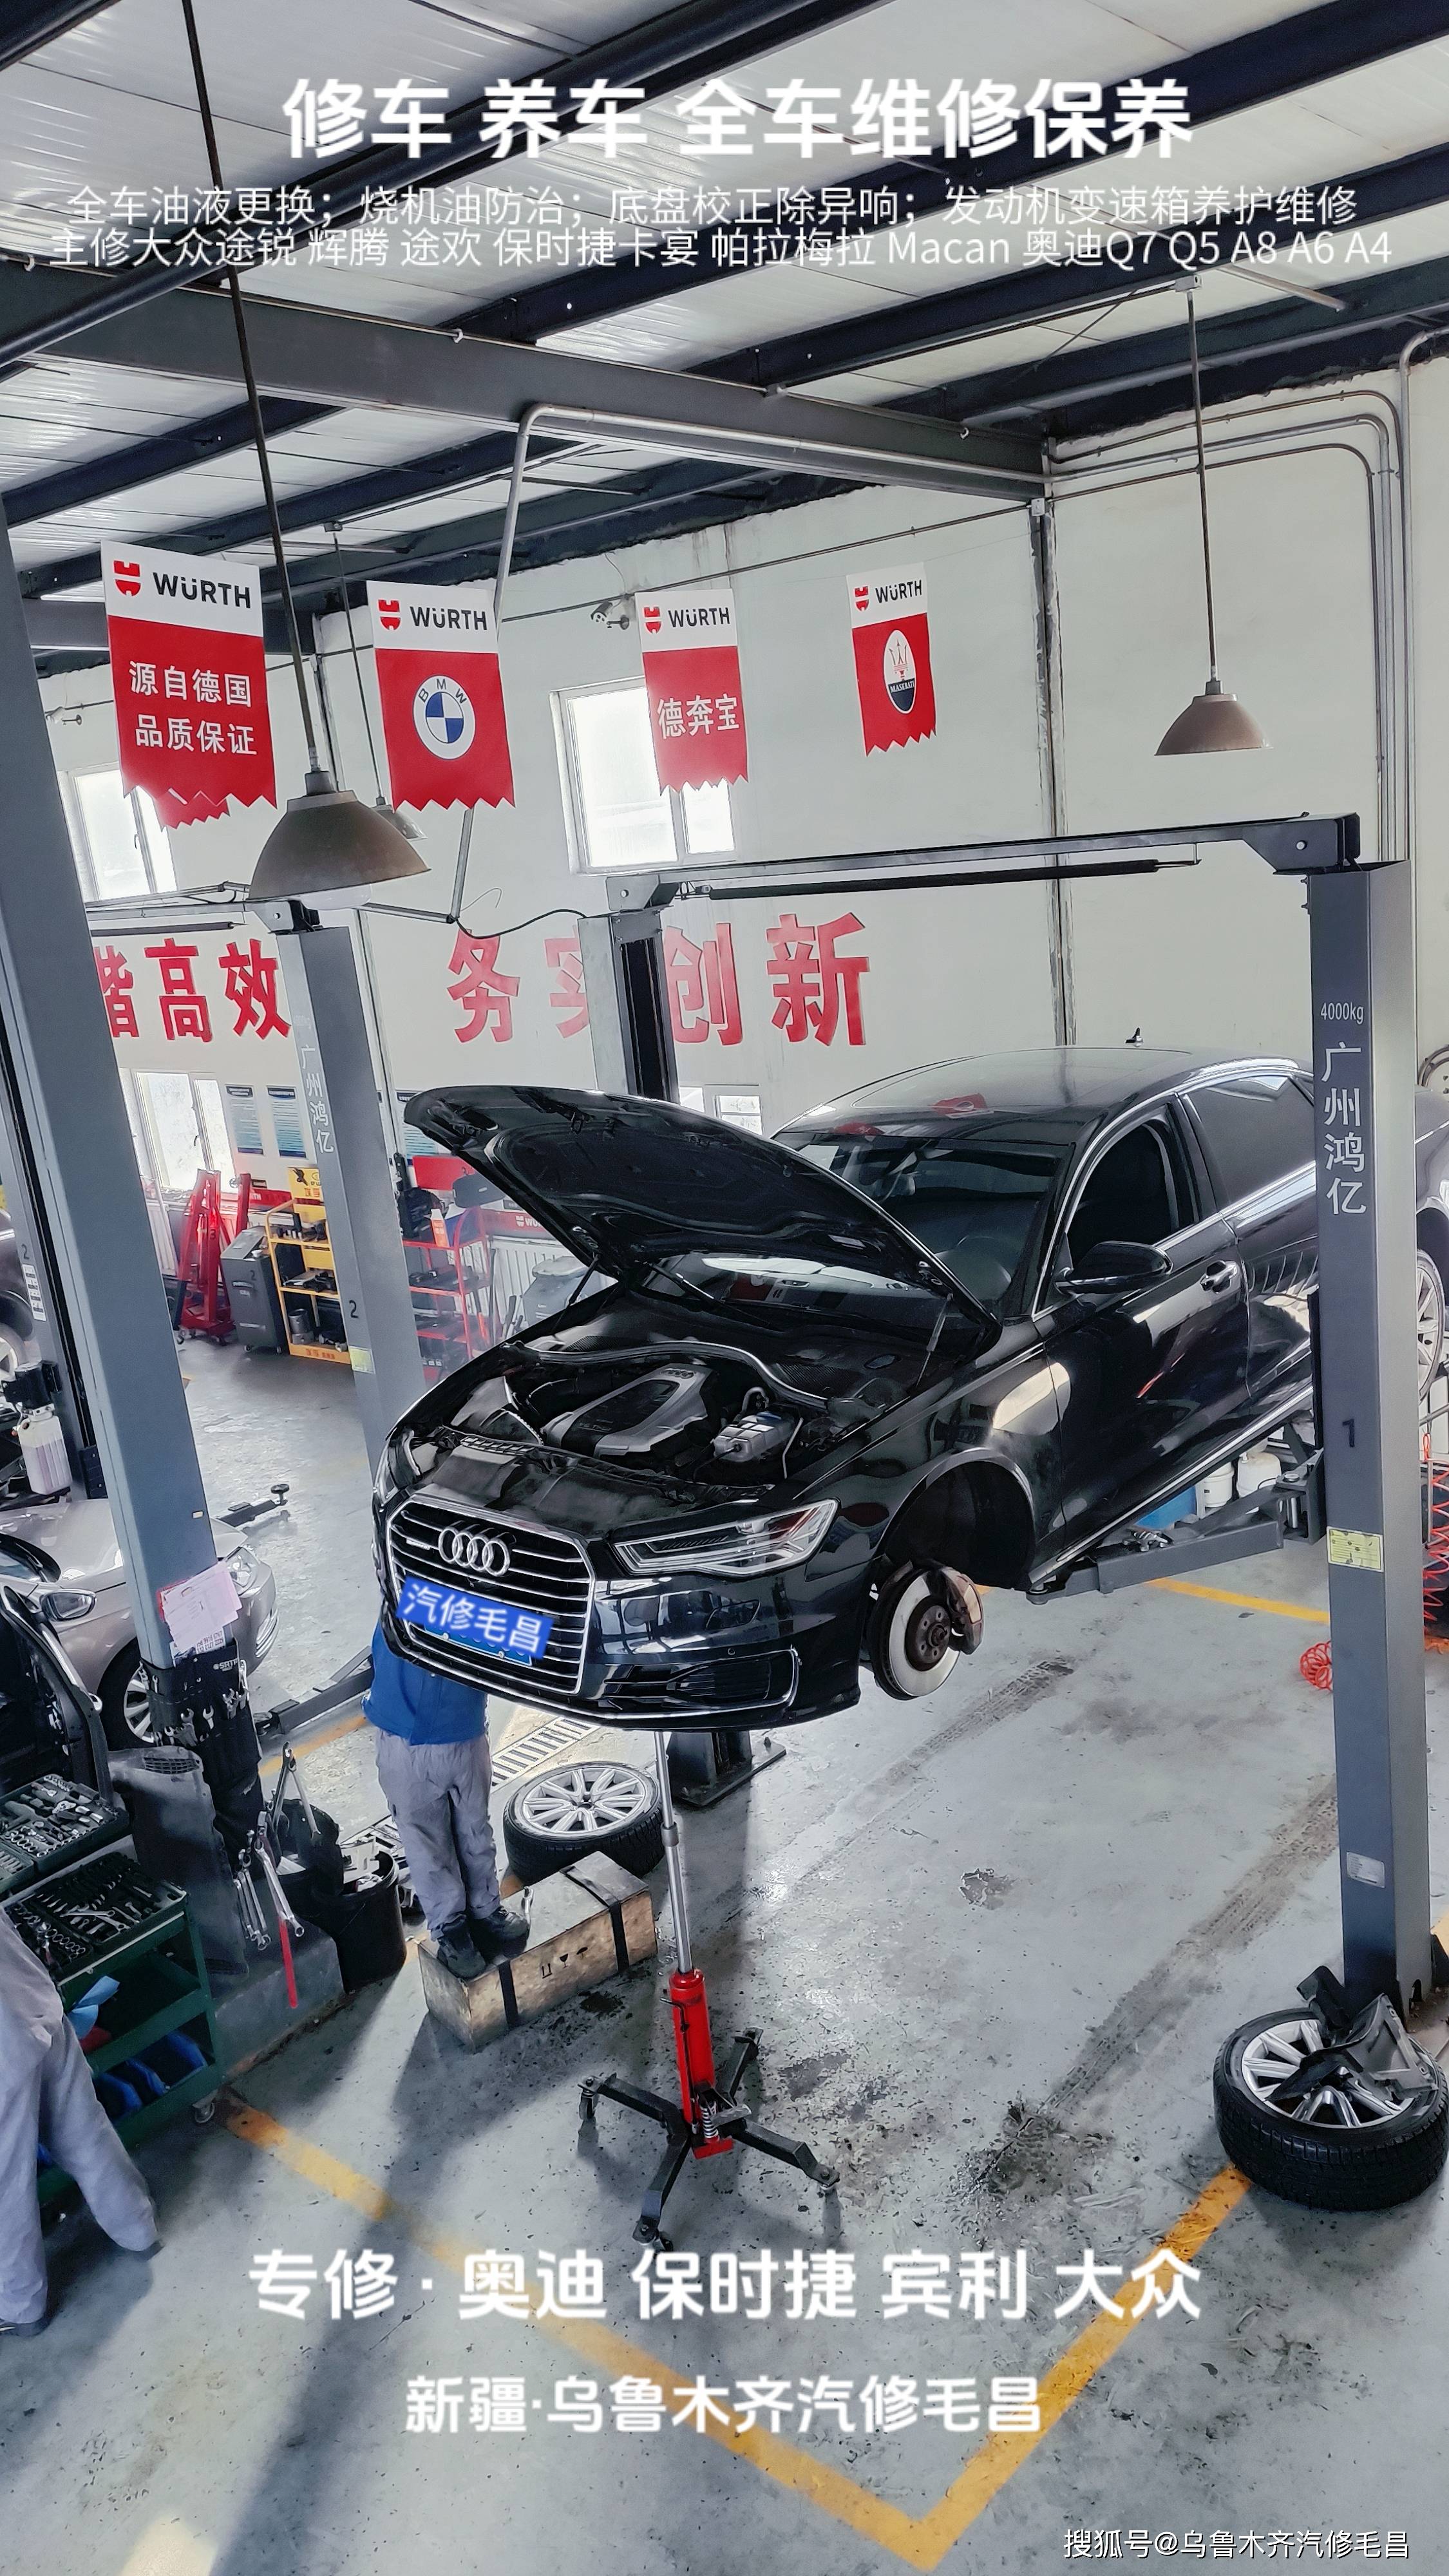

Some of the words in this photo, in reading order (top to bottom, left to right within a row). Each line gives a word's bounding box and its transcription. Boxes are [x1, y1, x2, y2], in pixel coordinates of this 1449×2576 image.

[129, 660, 252, 707] 源自德国
[418, 678, 468, 704] BMW
[657, 693, 740, 740] 德奔宝
[135, 714, 257, 755] 品质保证
[1320, 1001, 1365, 1025] 4000kg
[1321, 1041, 1367, 1215] 广州鸿亿
[21, 1243, 30, 1260] 2
[349, 1300, 359, 1319] 2
[1342, 1419, 1355, 1448] 1
